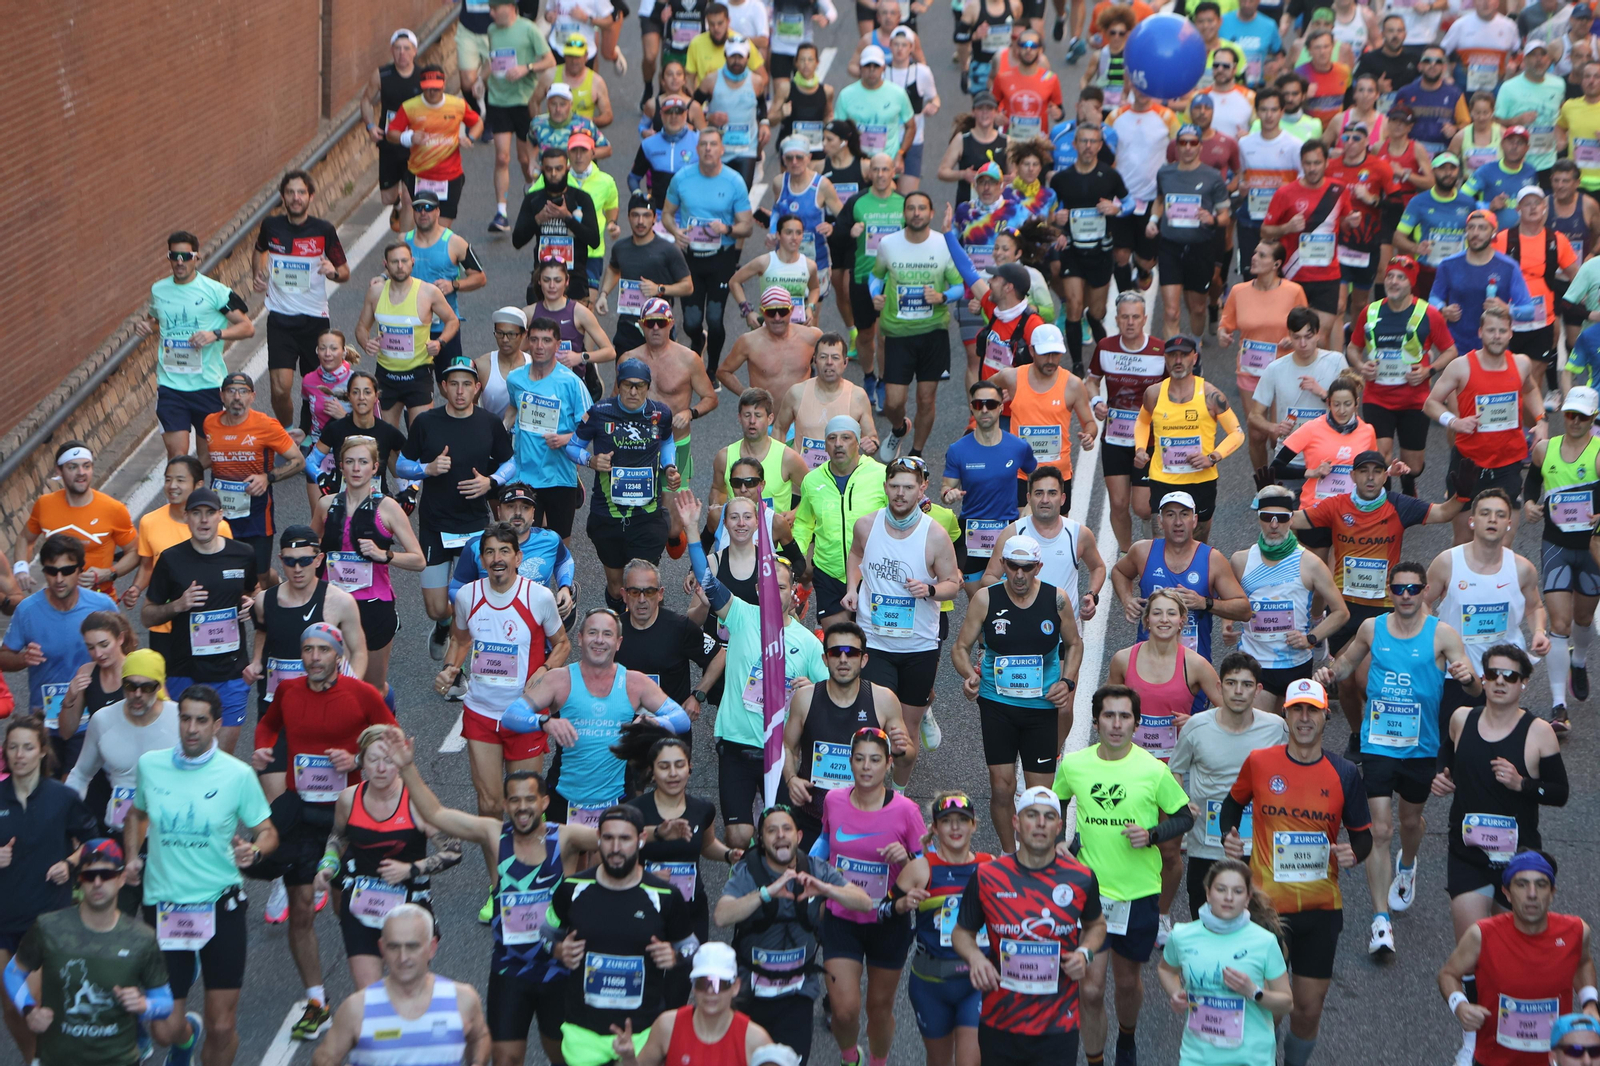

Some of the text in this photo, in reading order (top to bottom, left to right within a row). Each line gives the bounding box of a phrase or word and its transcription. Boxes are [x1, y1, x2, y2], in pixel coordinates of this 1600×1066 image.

[285, 261, 307, 270] ZURICH
[389, 327, 409, 335] ZURICH
[1251, 344, 1272, 352] ZURICH
[1115, 360, 1131, 368] HALF
[401, 373, 415, 382] MAX
[534, 397, 556, 408] ZURICH
[1490, 395, 1514, 405] ZURICH
[1034, 428, 1056, 436] ZURICH
[1031, 440, 1049, 448] 10527
[1172, 439, 1195, 448] ZURICH
[626, 470, 649, 478] ZURICH
[223, 484, 245, 493] ZURICH
[624, 483, 642, 491] 12348
[1561, 494, 1586, 502] ZURICH
[980, 522, 1004, 530] ZURICH
[1337, 533, 1396, 547] CDA CAMAS
[883, 557, 898, 567] THE
[1357, 560, 1382, 569] ZURICH
[869, 562, 898, 576] NORTH
[876, 571, 897, 582] FACE
[885, 598, 911, 607] ZURICH
[1263, 603, 1289, 611] ZURICH
[1478, 605, 1504, 614] ZURICH
[207, 614, 233, 623] ZURICH
[885, 612, 901, 620] 5652
[884, 620, 898, 628] LARS
[486, 644, 513, 653] ZURICH
[486, 658, 502, 667] 7058
[1011, 658, 1038, 667] ZURICH
[480, 666, 509, 675] LEONARDO
[1011, 672, 1027, 681] 5863
[1383, 671, 1412, 687] 26
[1009, 681, 1029, 689] DIABLO
[1379, 687, 1414, 699] Angel
[1387, 705, 1414, 714] ZURICH
[574, 717, 614, 728] ASHFORD
[1144, 717, 1171, 726] ZURICH
[1386, 720, 1402, 729] 5374
[1385, 730, 1403, 738] ANGEL
[1141, 741, 1162, 750] JEANNE
[829, 762, 847, 771] 4279
[823, 770, 852, 781] BARREIRO
[1261, 804, 1288, 816] CDA
[1290, 806, 1337, 823] CAMAS
[1085, 816, 1091, 826] A
[1091, 816, 1109, 827] POR
[1481, 819, 1511, 829] ZURICH
[1293, 834, 1324, 844] ZURICH
[853, 862, 883, 874] ZURICH
[518, 892, 550, 905] ZURICH
[1020, 945, 1052, 956] ZURICH
[770, 952, 801, 964] ZURICH
[605, 960, 638, 970] ZURICH
[1207, 998, 1237, 1010] ZURICH
[1519, 1003, 1552, 1013] ZURICH
